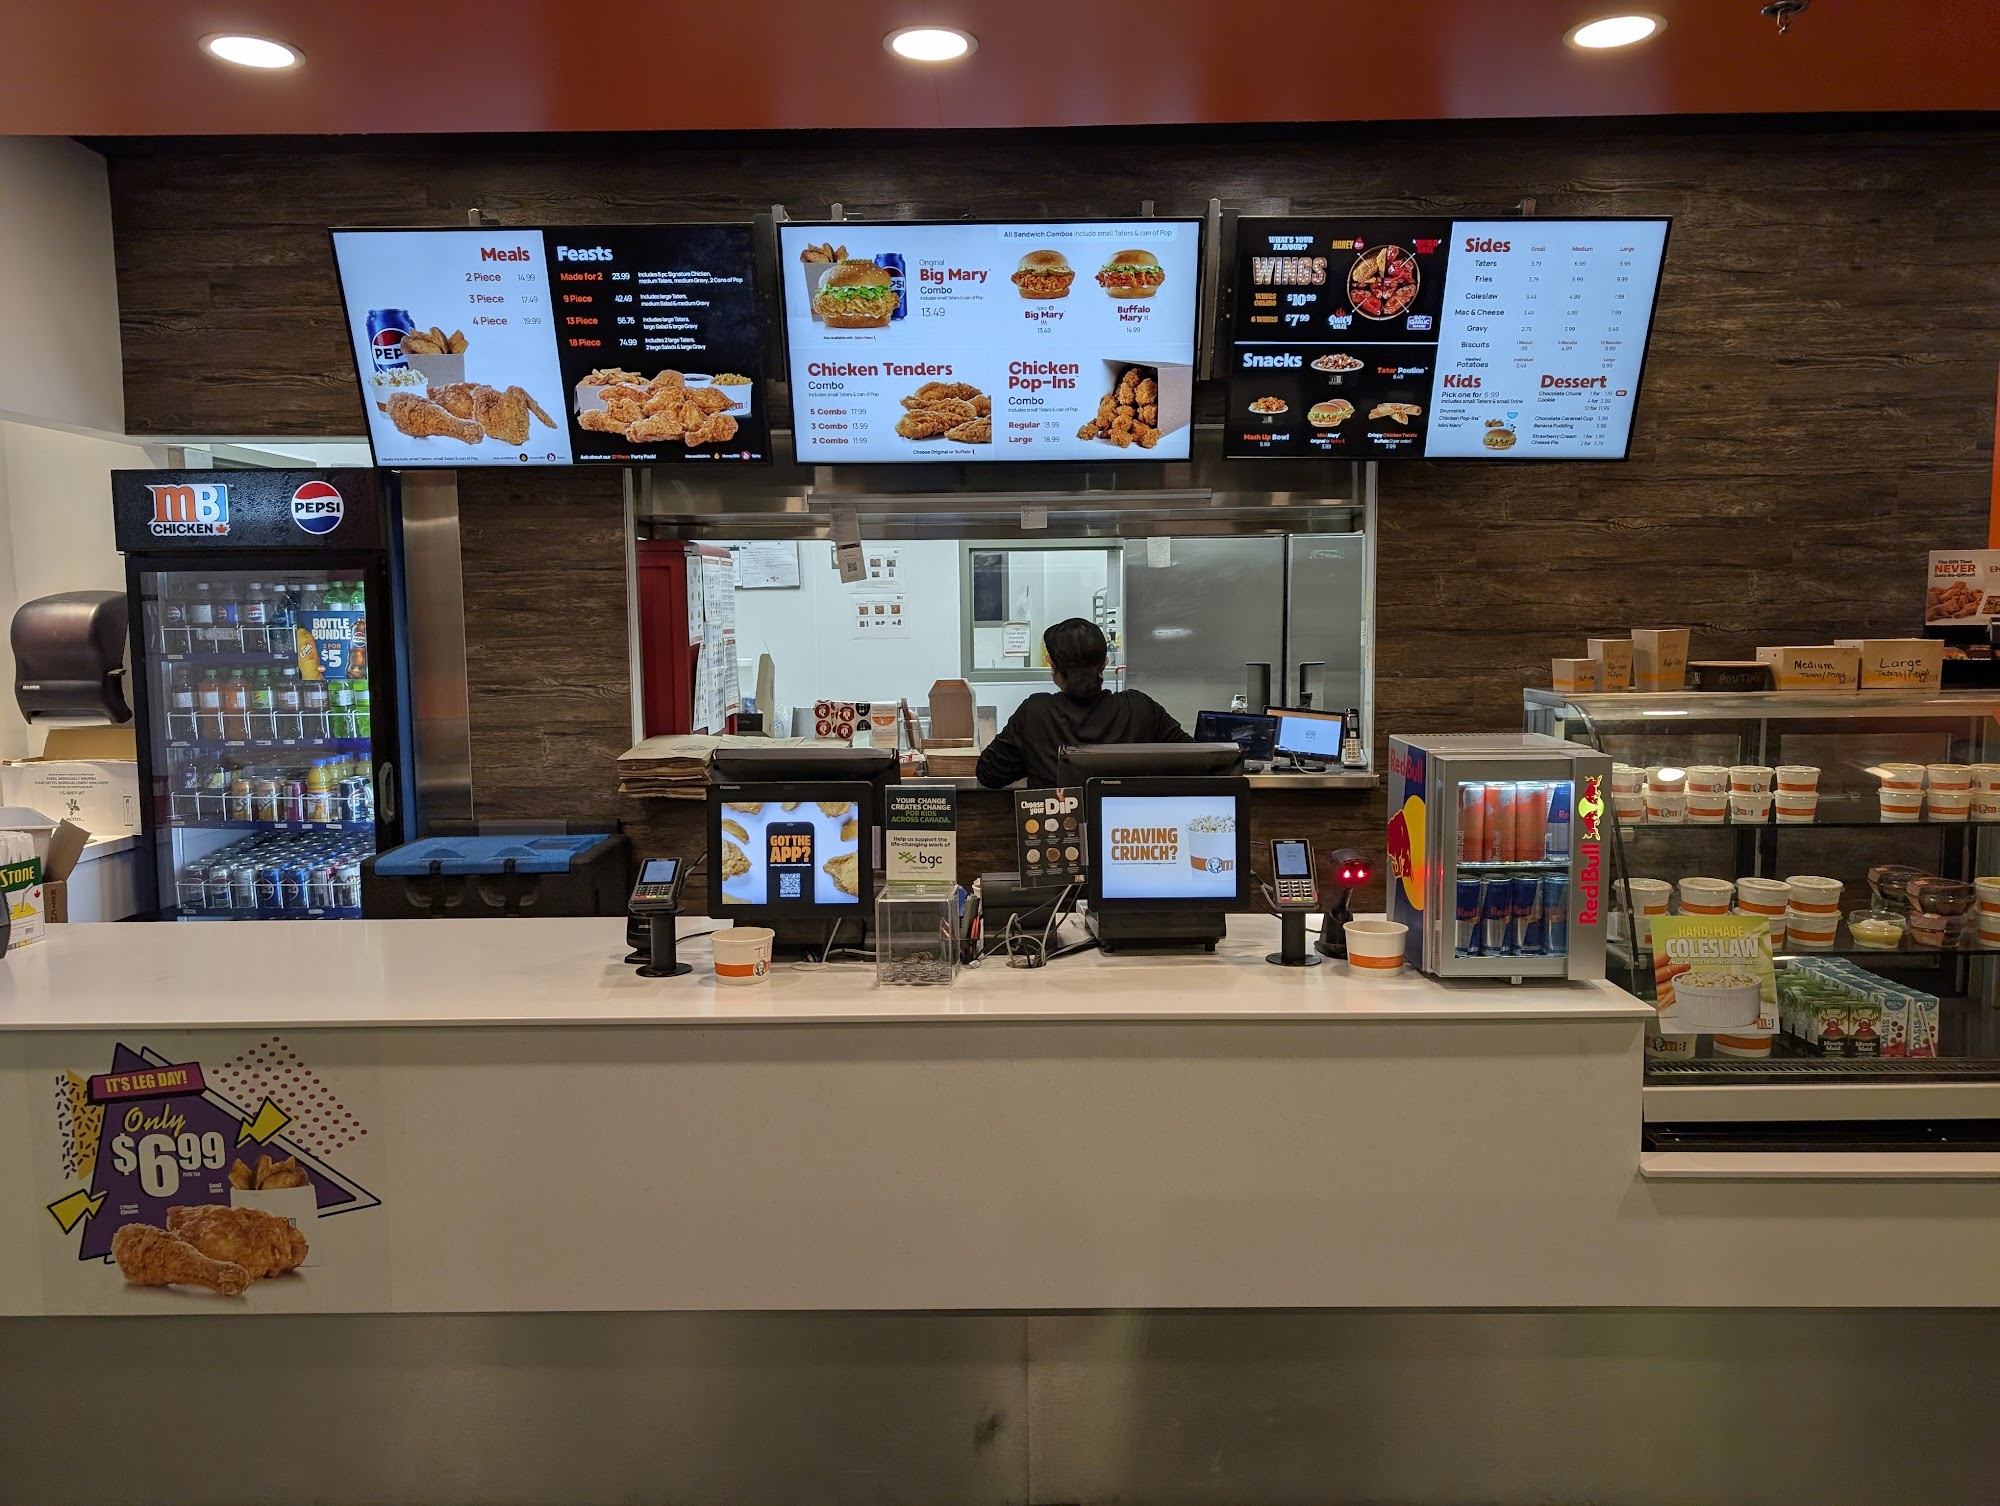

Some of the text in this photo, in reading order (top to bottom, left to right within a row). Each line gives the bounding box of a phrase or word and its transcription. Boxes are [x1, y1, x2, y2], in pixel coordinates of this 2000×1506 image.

[1332, 240, 1354, 249] HONEY
[1465, 238, 1511, 253] Sides
[480, 247, 530, 262] Meals
[556, 245, 613, 262] Feasts
[919, 259, 945, 267] Original
[560, 272, 583, 281] Made
[584, 272, 596, 281] for
[920, 269, 987, 284] Big Mary
[1252, 257, 1327, 285] WINGS
[466, 273, 535, 282] 2 Piece 14.99
[1475, 275, 1493, 283] Fries
[920, 286, 952, 294] Combo
[469, 295, 538, 304] 3 Piece 17.49
[563, 295, 569, 303] 9
[570, 295, 592, 303] Piece
[921, 308, 945, 317] 13.49
[1117, 305, 1150, 313] Buffalo
[473, 317, 541, 325] 4 Piece 19.99
[1025, 311, 1064, 320] Big Mary
[1120, 314, 1142, 322] Mary
[1467, 325, 1488, 333] Gravy
[1243, 353, 1302, 368] Snacks
[807, 362, 953, 377] Chicken Tenders
[1009, 361, 1079, 375] Chicken
[808, 381, 844, 390] Combo
[1009, 376, 1076, 392] Pop-Ins
[1443, 374, 1482, 388] Kids
[1540, 375, 1607, 389] Dessert
[1008, 397, 1044, 405] Combo
[1008, 422, 1040, 430] Regular
[1008, 436, 1032, 444] Large
[1262, 434, 1271, 442] Up
[1272, 433, 1289, 441] Bowl
[295, 502, 340, 513] PEPSI
[153, 523, 214, 534] CHICKEN
[1934, 565, 1976, 573] NEVER
[312, 618, 349, 629] BOTTLE
[312, 629, 351, 640] BUNDLE
[321, 650, 342, 667] $5
[1794, 660, 1834, 669] Medium
[1880, 658, 1922, 671] Large
[1390, 748, 1423, 785] Red Bull
[1021, 801, 1044, 809] Choose
[1030, 807, 1044, 815] your
[770, 835, 811, 846] GOT THE
[1111, 827, 1178, 844] CRAVING
[770, 847, 811, 863] APP?
[1111, 845, 1178, 861] CRUNCH?
[920, 851, 943, 868] bgc
[1579, 843, 1600, 926] Red Bull
[1679, 926, 1744, 938] HAND-MADE
[1666, 938, 1759, 958] COLESLAW
[1882, 1020, 1890, 1048] OASIS
[1913, 1020, 1921, 1048] OASIS
[106, 1070, 187, 1092] IT'S LEG DAY!
[124, 1104, 186, 1137] Only
